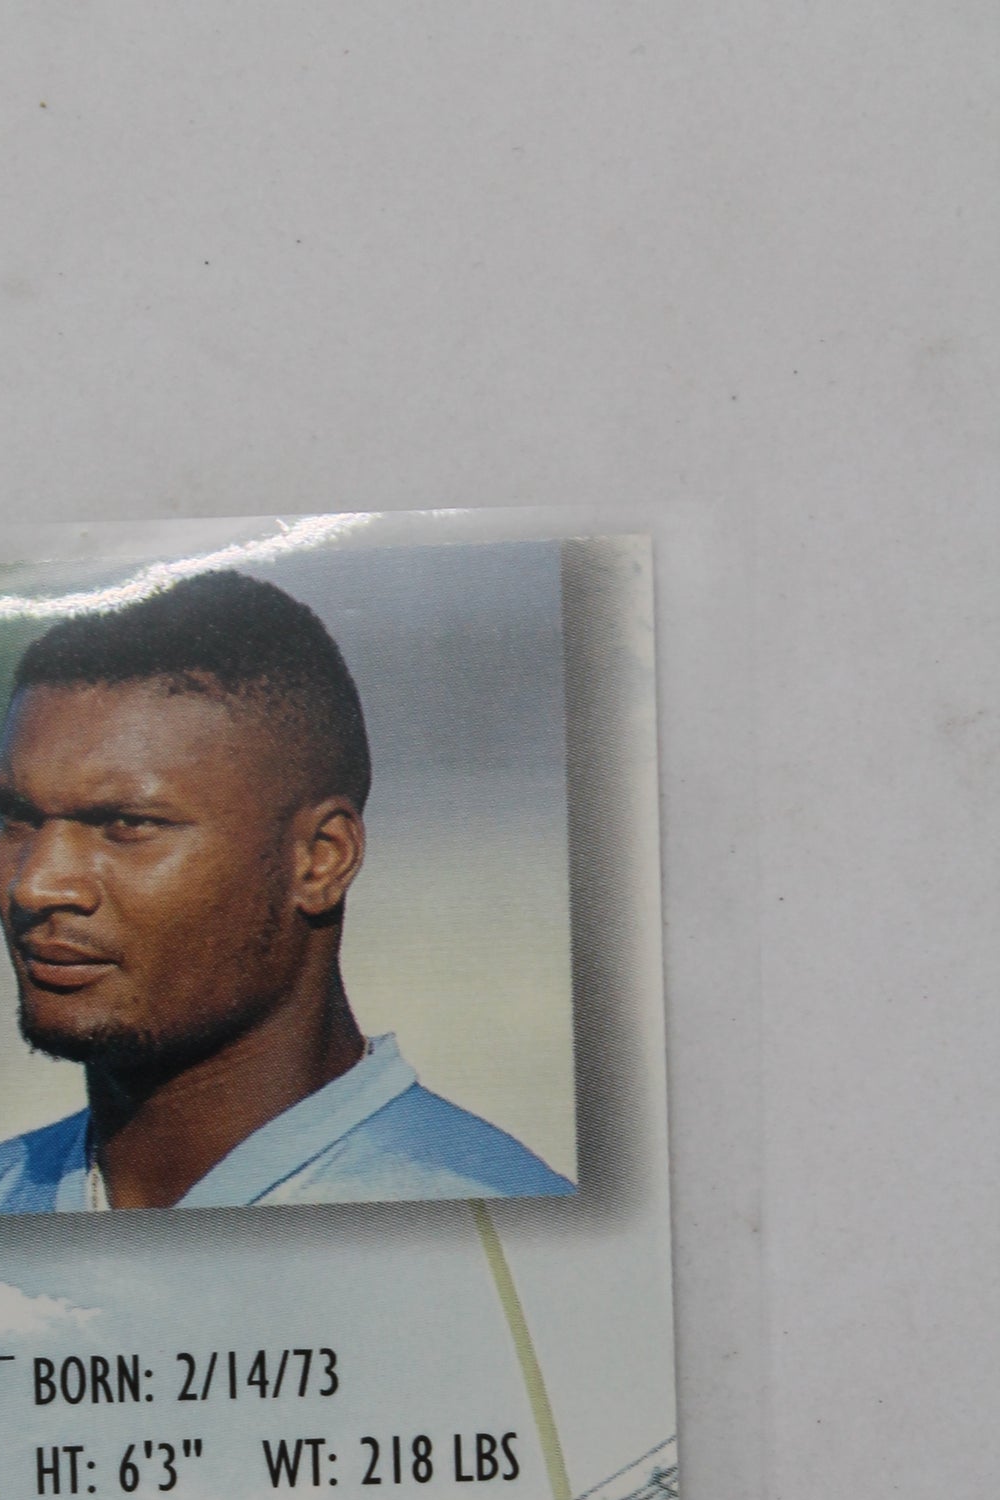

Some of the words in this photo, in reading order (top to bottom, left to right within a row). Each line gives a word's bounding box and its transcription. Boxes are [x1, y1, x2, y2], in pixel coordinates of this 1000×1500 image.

[34, 1355, 154, 1405] BORN:
[176, 1348, 339, 1400] 2/14/73
[37, 1445, 96, 1494] HT:
[263, 1438, 338, 1488] WT:
[361, 1434, 433, 1485] 218
[455, 1432, 520, 1483] LBS
